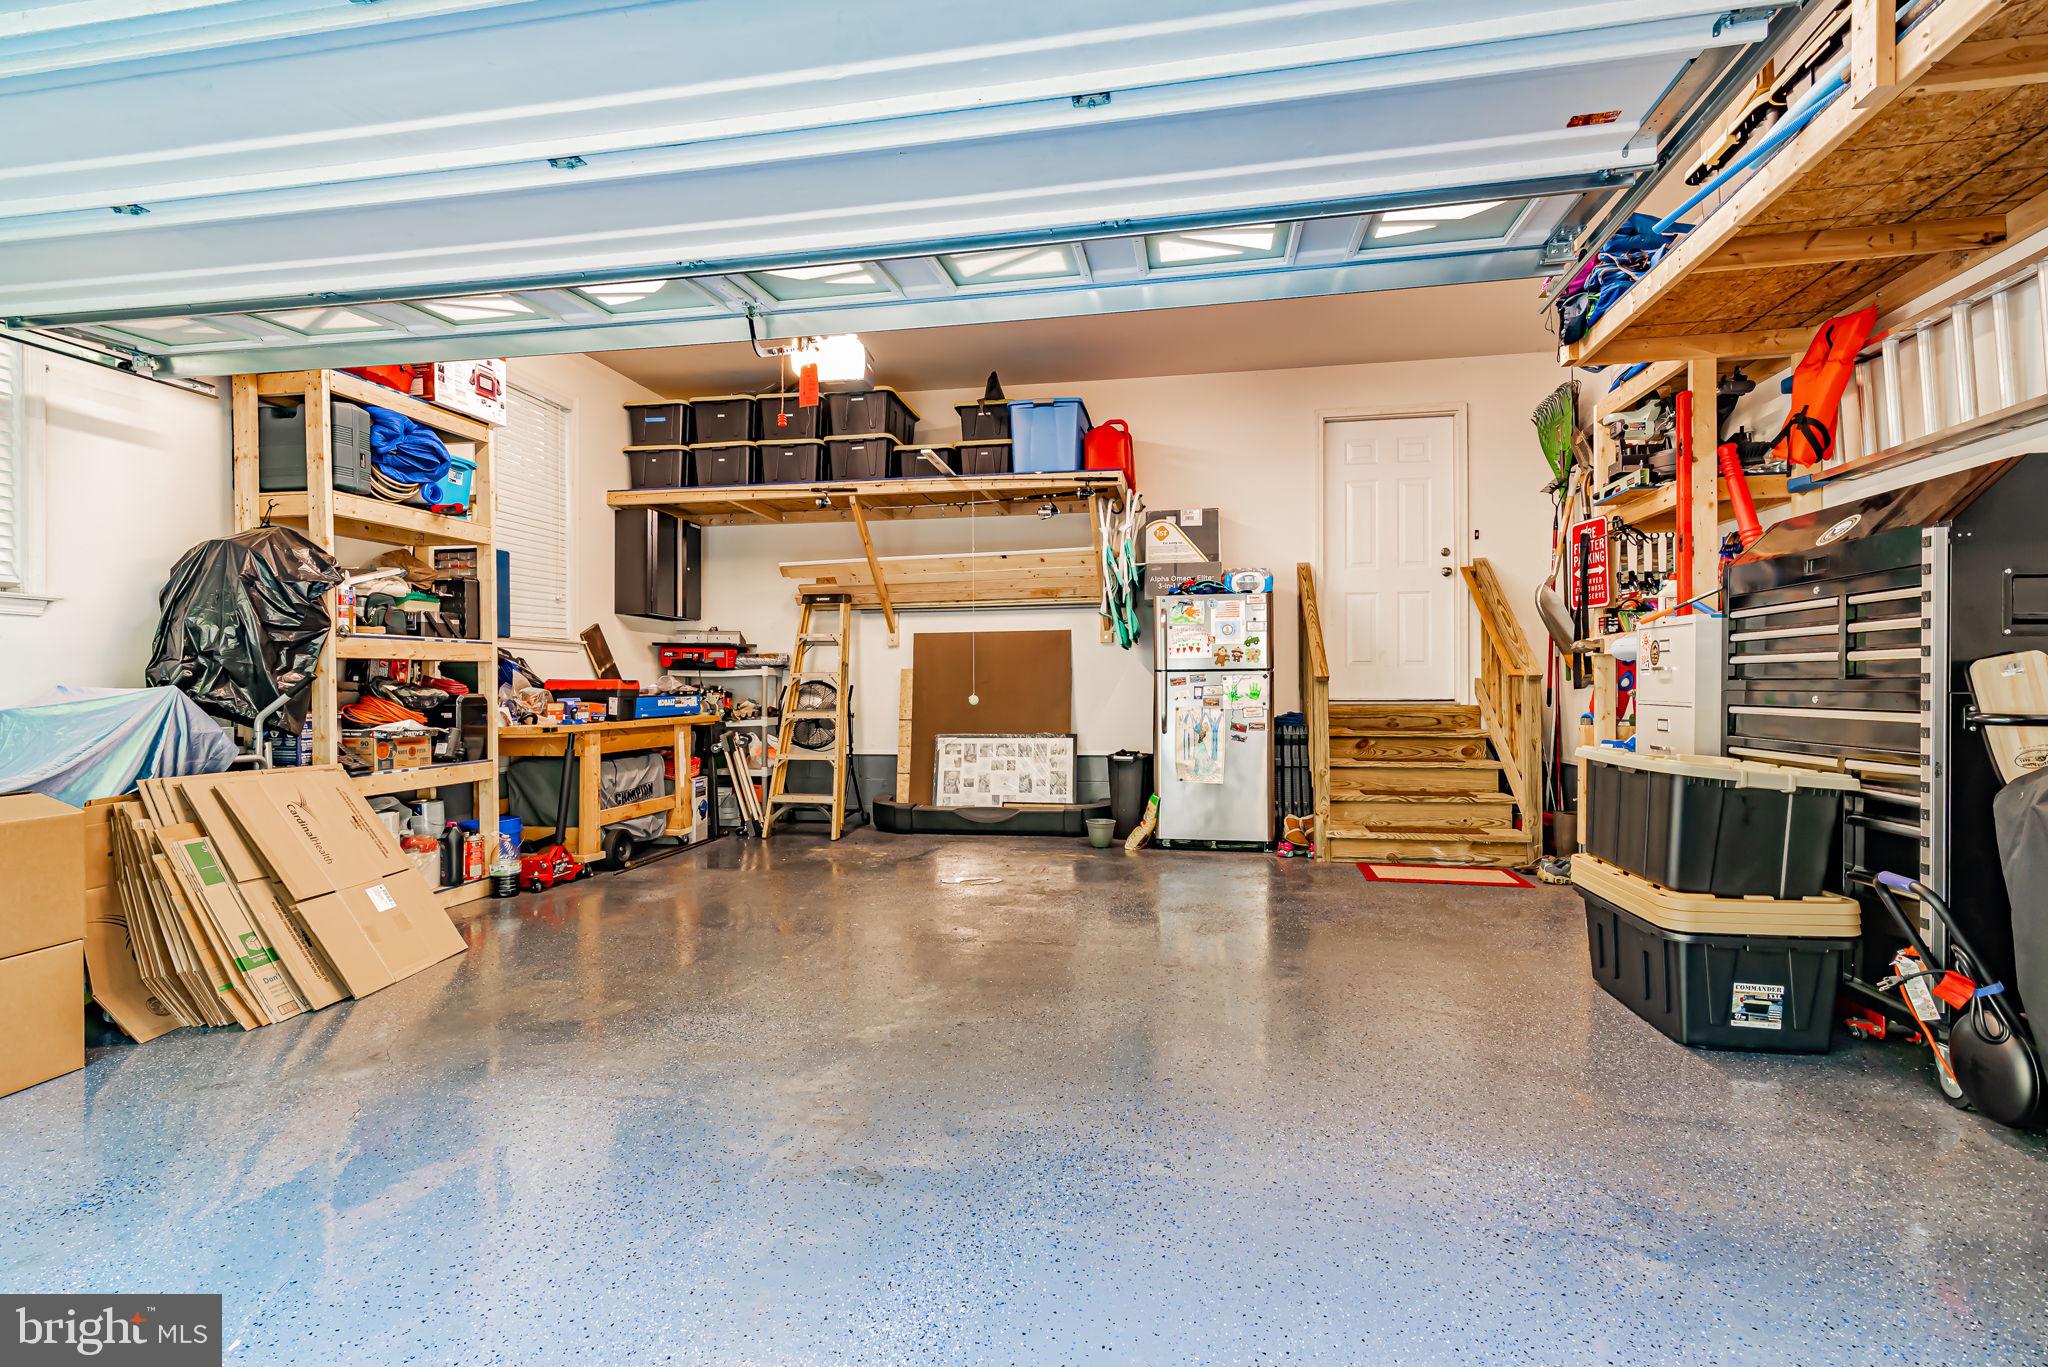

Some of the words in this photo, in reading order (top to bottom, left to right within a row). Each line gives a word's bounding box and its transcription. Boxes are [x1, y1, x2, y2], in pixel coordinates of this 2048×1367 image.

[1573, 551, 1605, 567] PKING
[1150, 575, 1169, 583] Alpha
[1576, 577, 1602, 587] RRVED
[1588, 591, 1605, 600] SERVE
[615, 782, 653, 805] CHAMPION
[1735, 984, 1782, 993] COMMANDER
